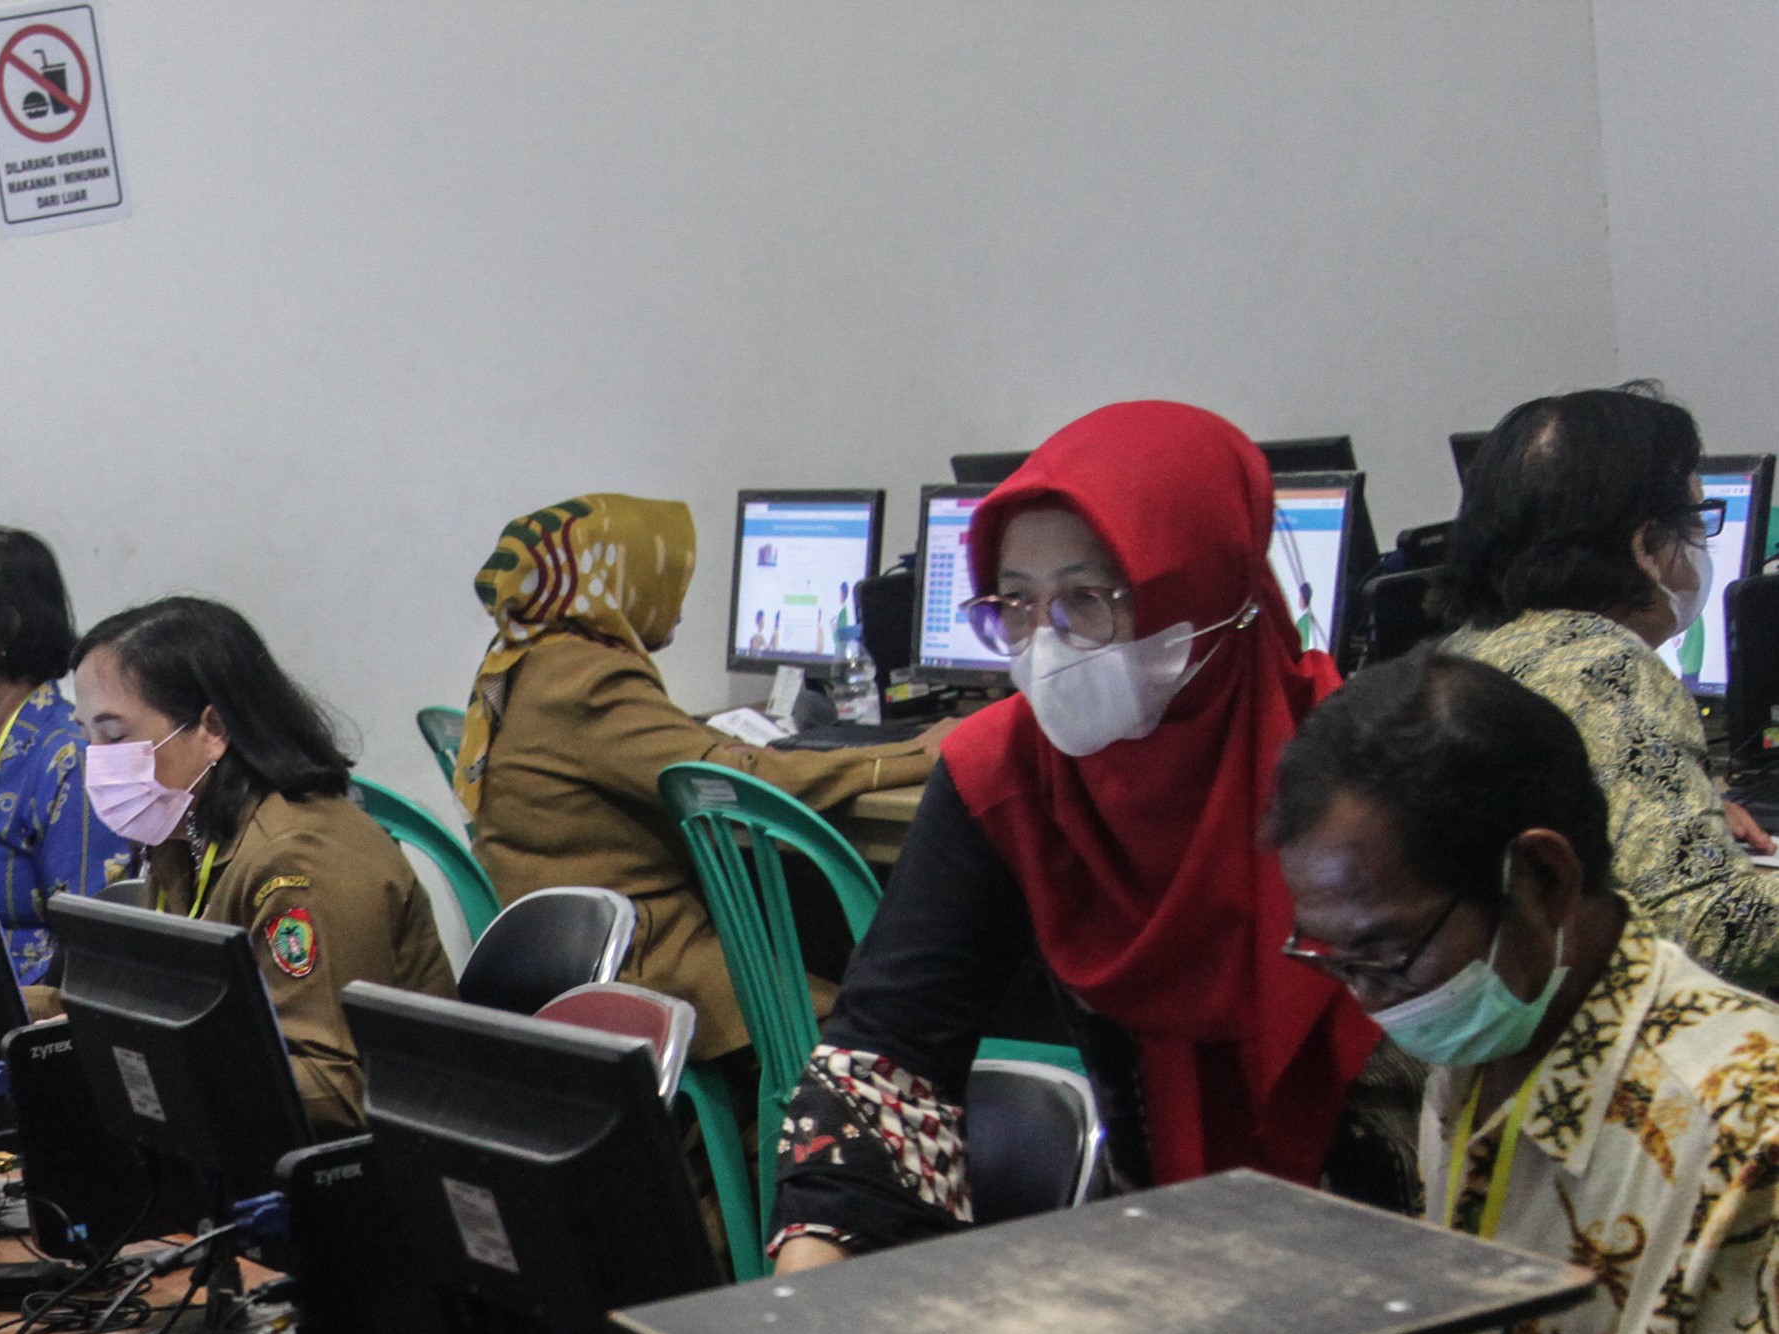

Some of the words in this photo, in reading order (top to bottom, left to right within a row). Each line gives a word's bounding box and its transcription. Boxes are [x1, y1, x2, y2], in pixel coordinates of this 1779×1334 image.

[5, 155, 55, 175] DILARANG
[57, 147, 107, 166] MEMBAWA
[8, 175, 57, 194] MAKANAN
[64, 166, 110, 184] MINUMAN
[37, 194, 60, 209] DARI
[62, 189, 88, 204] LUAR
[30, 1039, 74, 1060] zyrex
